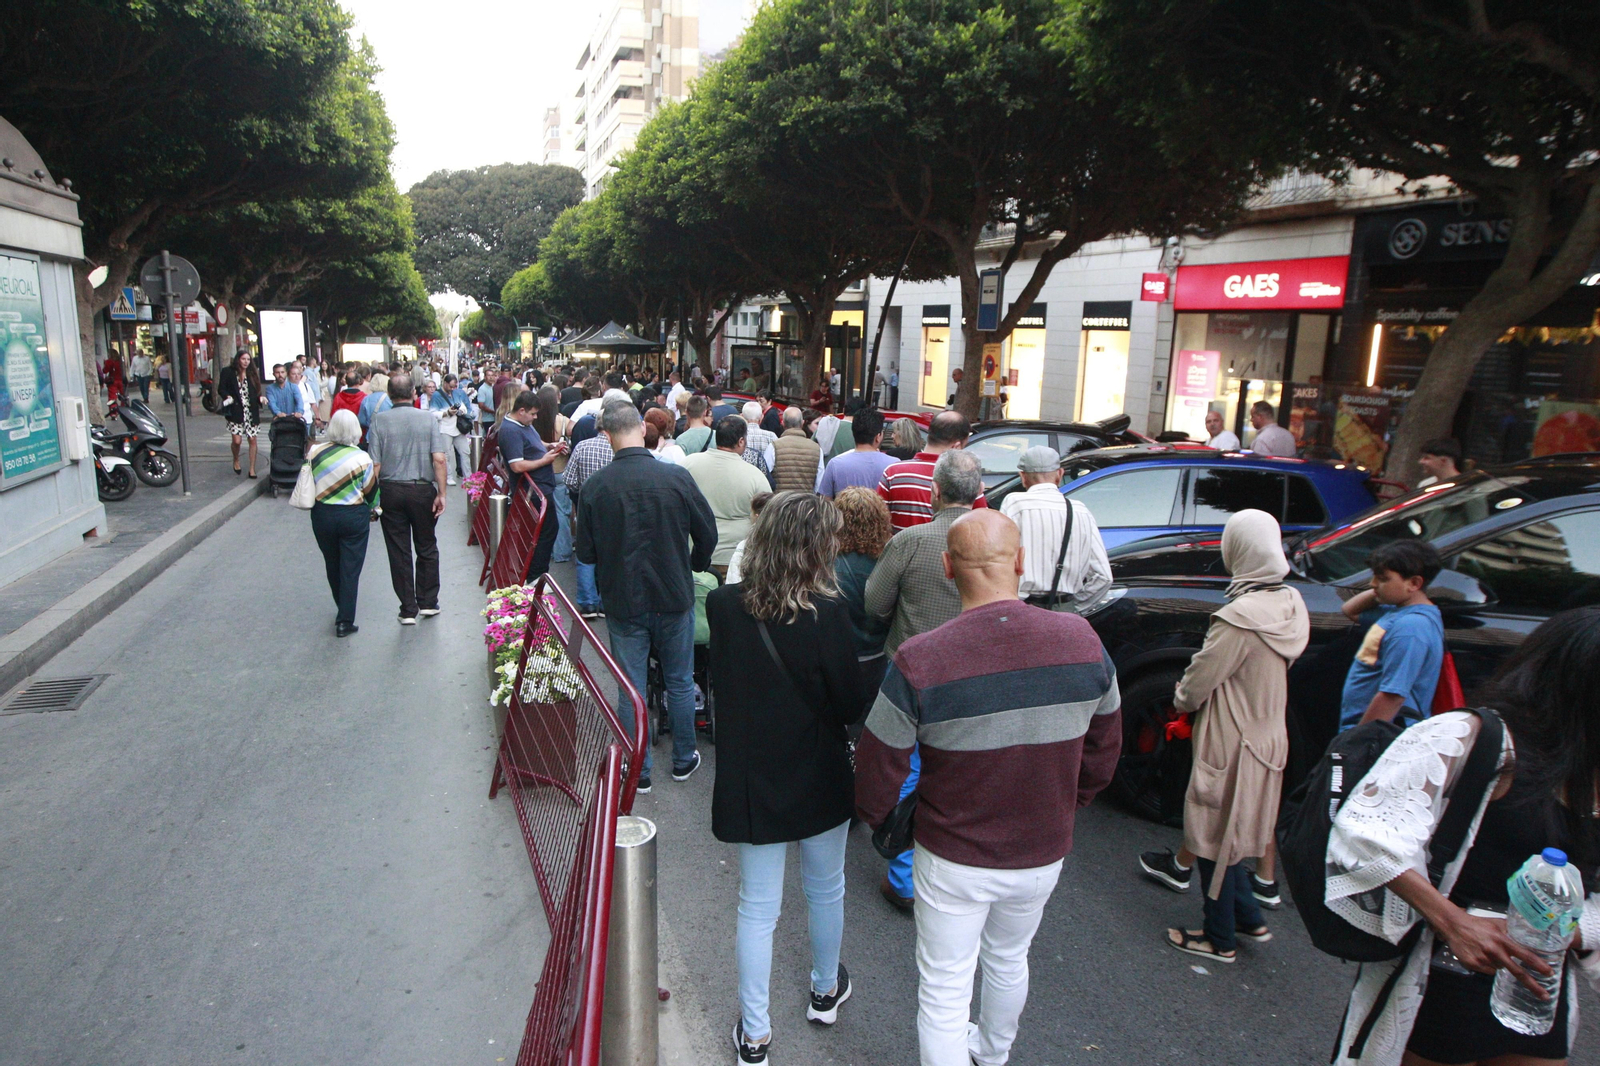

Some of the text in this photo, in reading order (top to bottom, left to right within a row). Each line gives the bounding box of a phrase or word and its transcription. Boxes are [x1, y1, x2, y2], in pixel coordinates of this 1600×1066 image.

[1144, 281, 1165, 291] GAES
[1224, 273, 1280, 298] GAES
[1376, 307, 1459, 322] Specialty coffee
[1082, 317, 1128, 327] CORTEFIEL
[12, 388, 36, 402] UNESPA
[1331, 765, 1343, 792] PUMA
